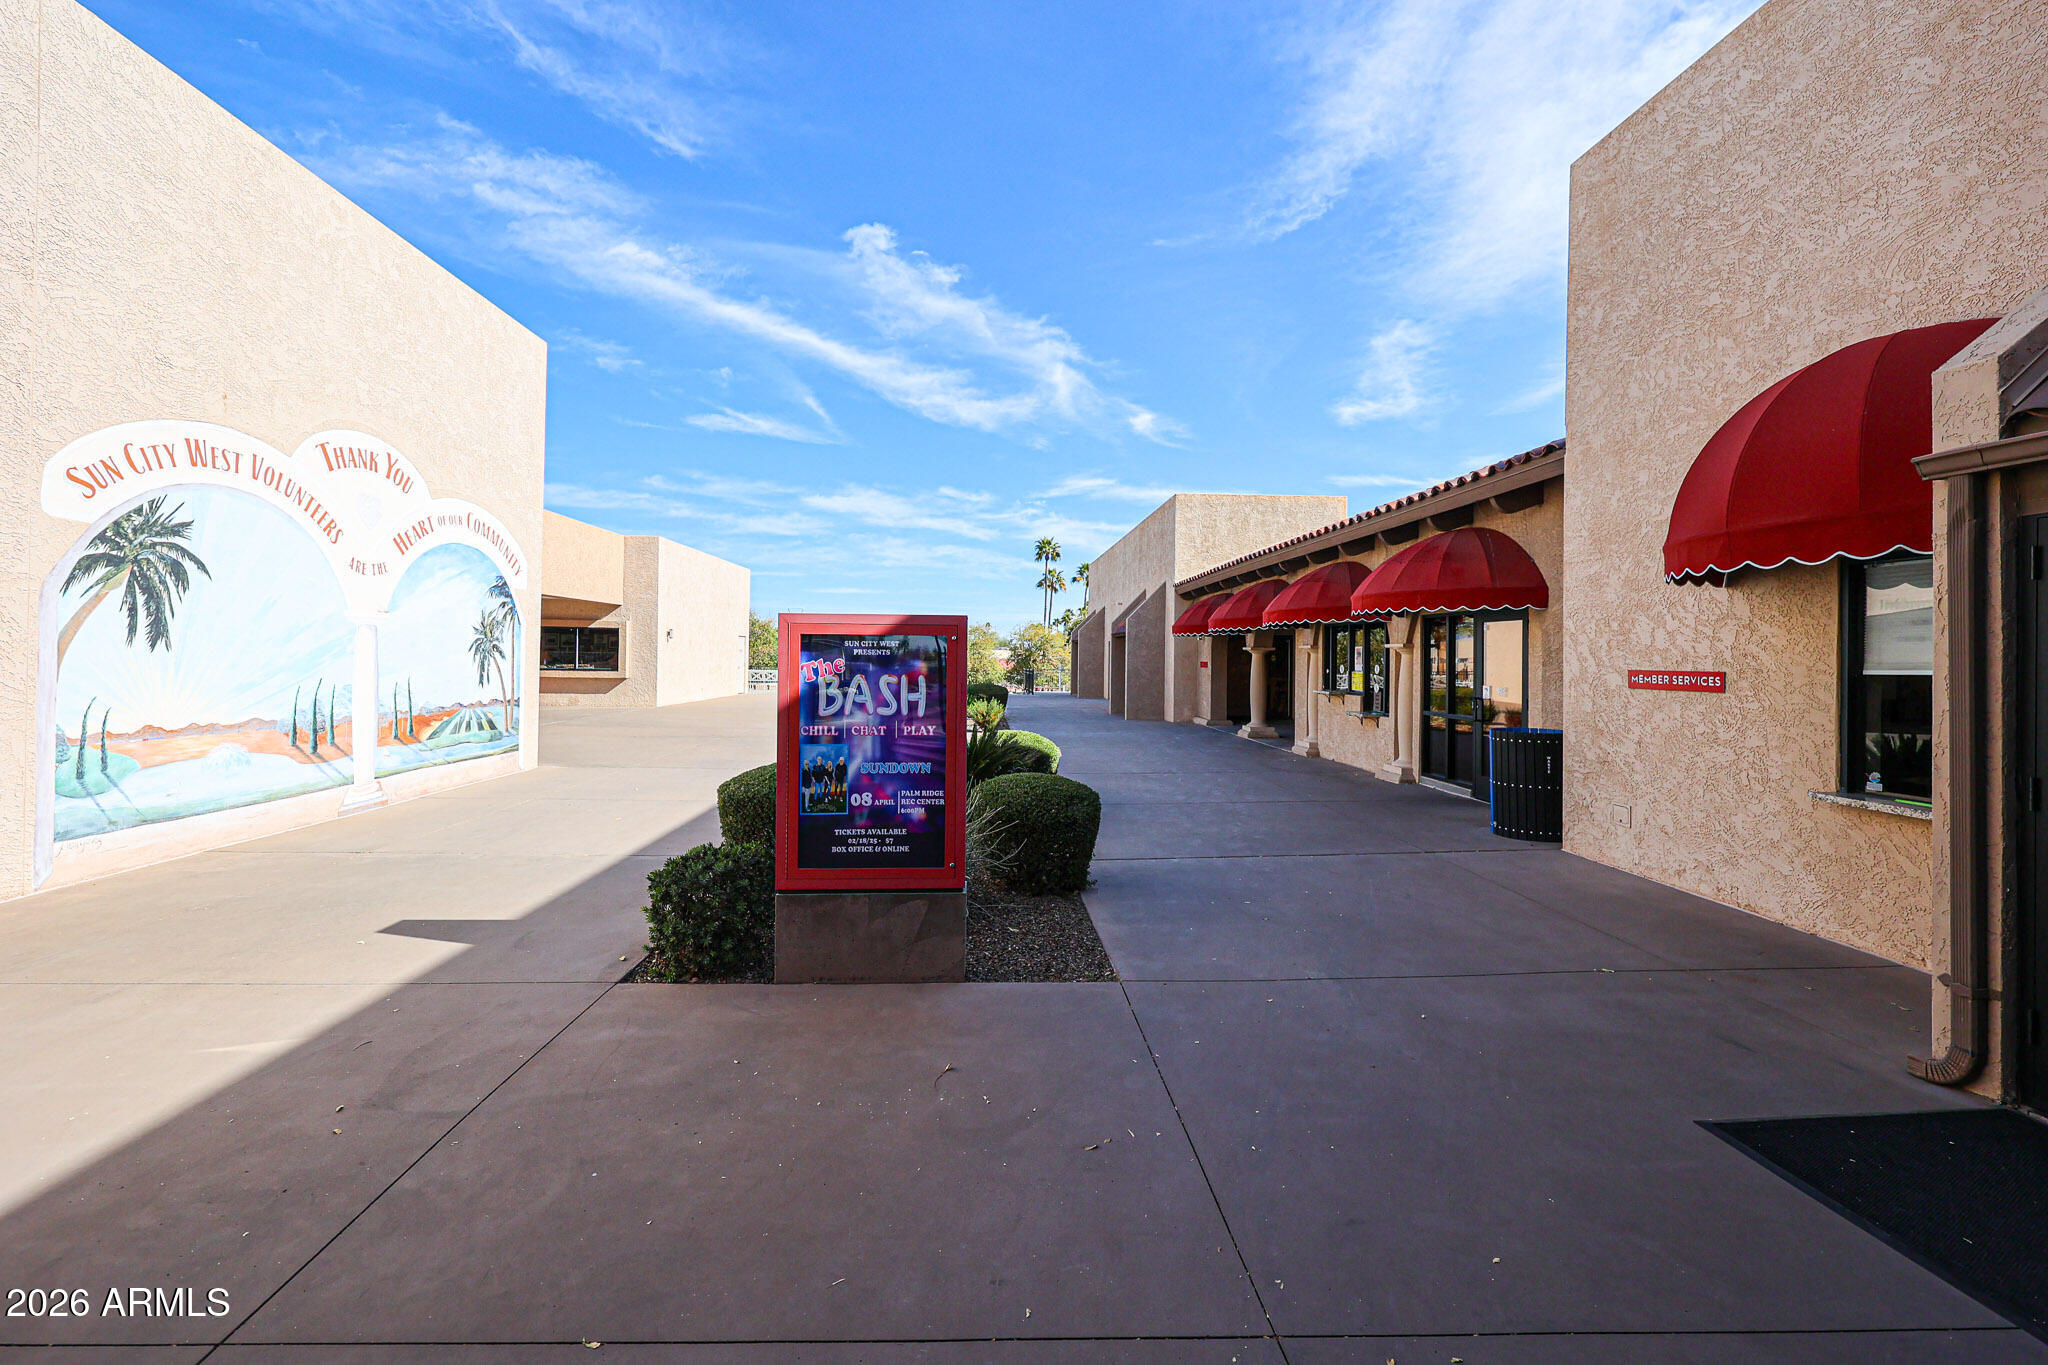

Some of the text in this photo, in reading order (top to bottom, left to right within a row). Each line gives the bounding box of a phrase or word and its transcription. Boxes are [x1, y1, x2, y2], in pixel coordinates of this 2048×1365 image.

[315, 442, 414, 494] THANK YOU
[66, 437, 344, 545] SUN CITY WEST VOLUNTEERS
[392, 511, 523, 576] HEART OF OUR COMMUNITY
[349, 556, 388, 576] ARE THE
[853, 648, 891, 656] PRESENTS
[800, 658, 846, 682] The
[1631, 674, 1722, 687] MEMBER SERVICES
[818, 673, 927, 717] BASH
[800, 725, 937, 736] CHILL CHAT PLAY
[860, 762, 931, 774] SUNDOWN
[850, 791, 873, 807] 08
[831, 845, 847, 853] BOX
[848, 845, 874, 853] OFFICE
[875, 845, 882, 853] &
